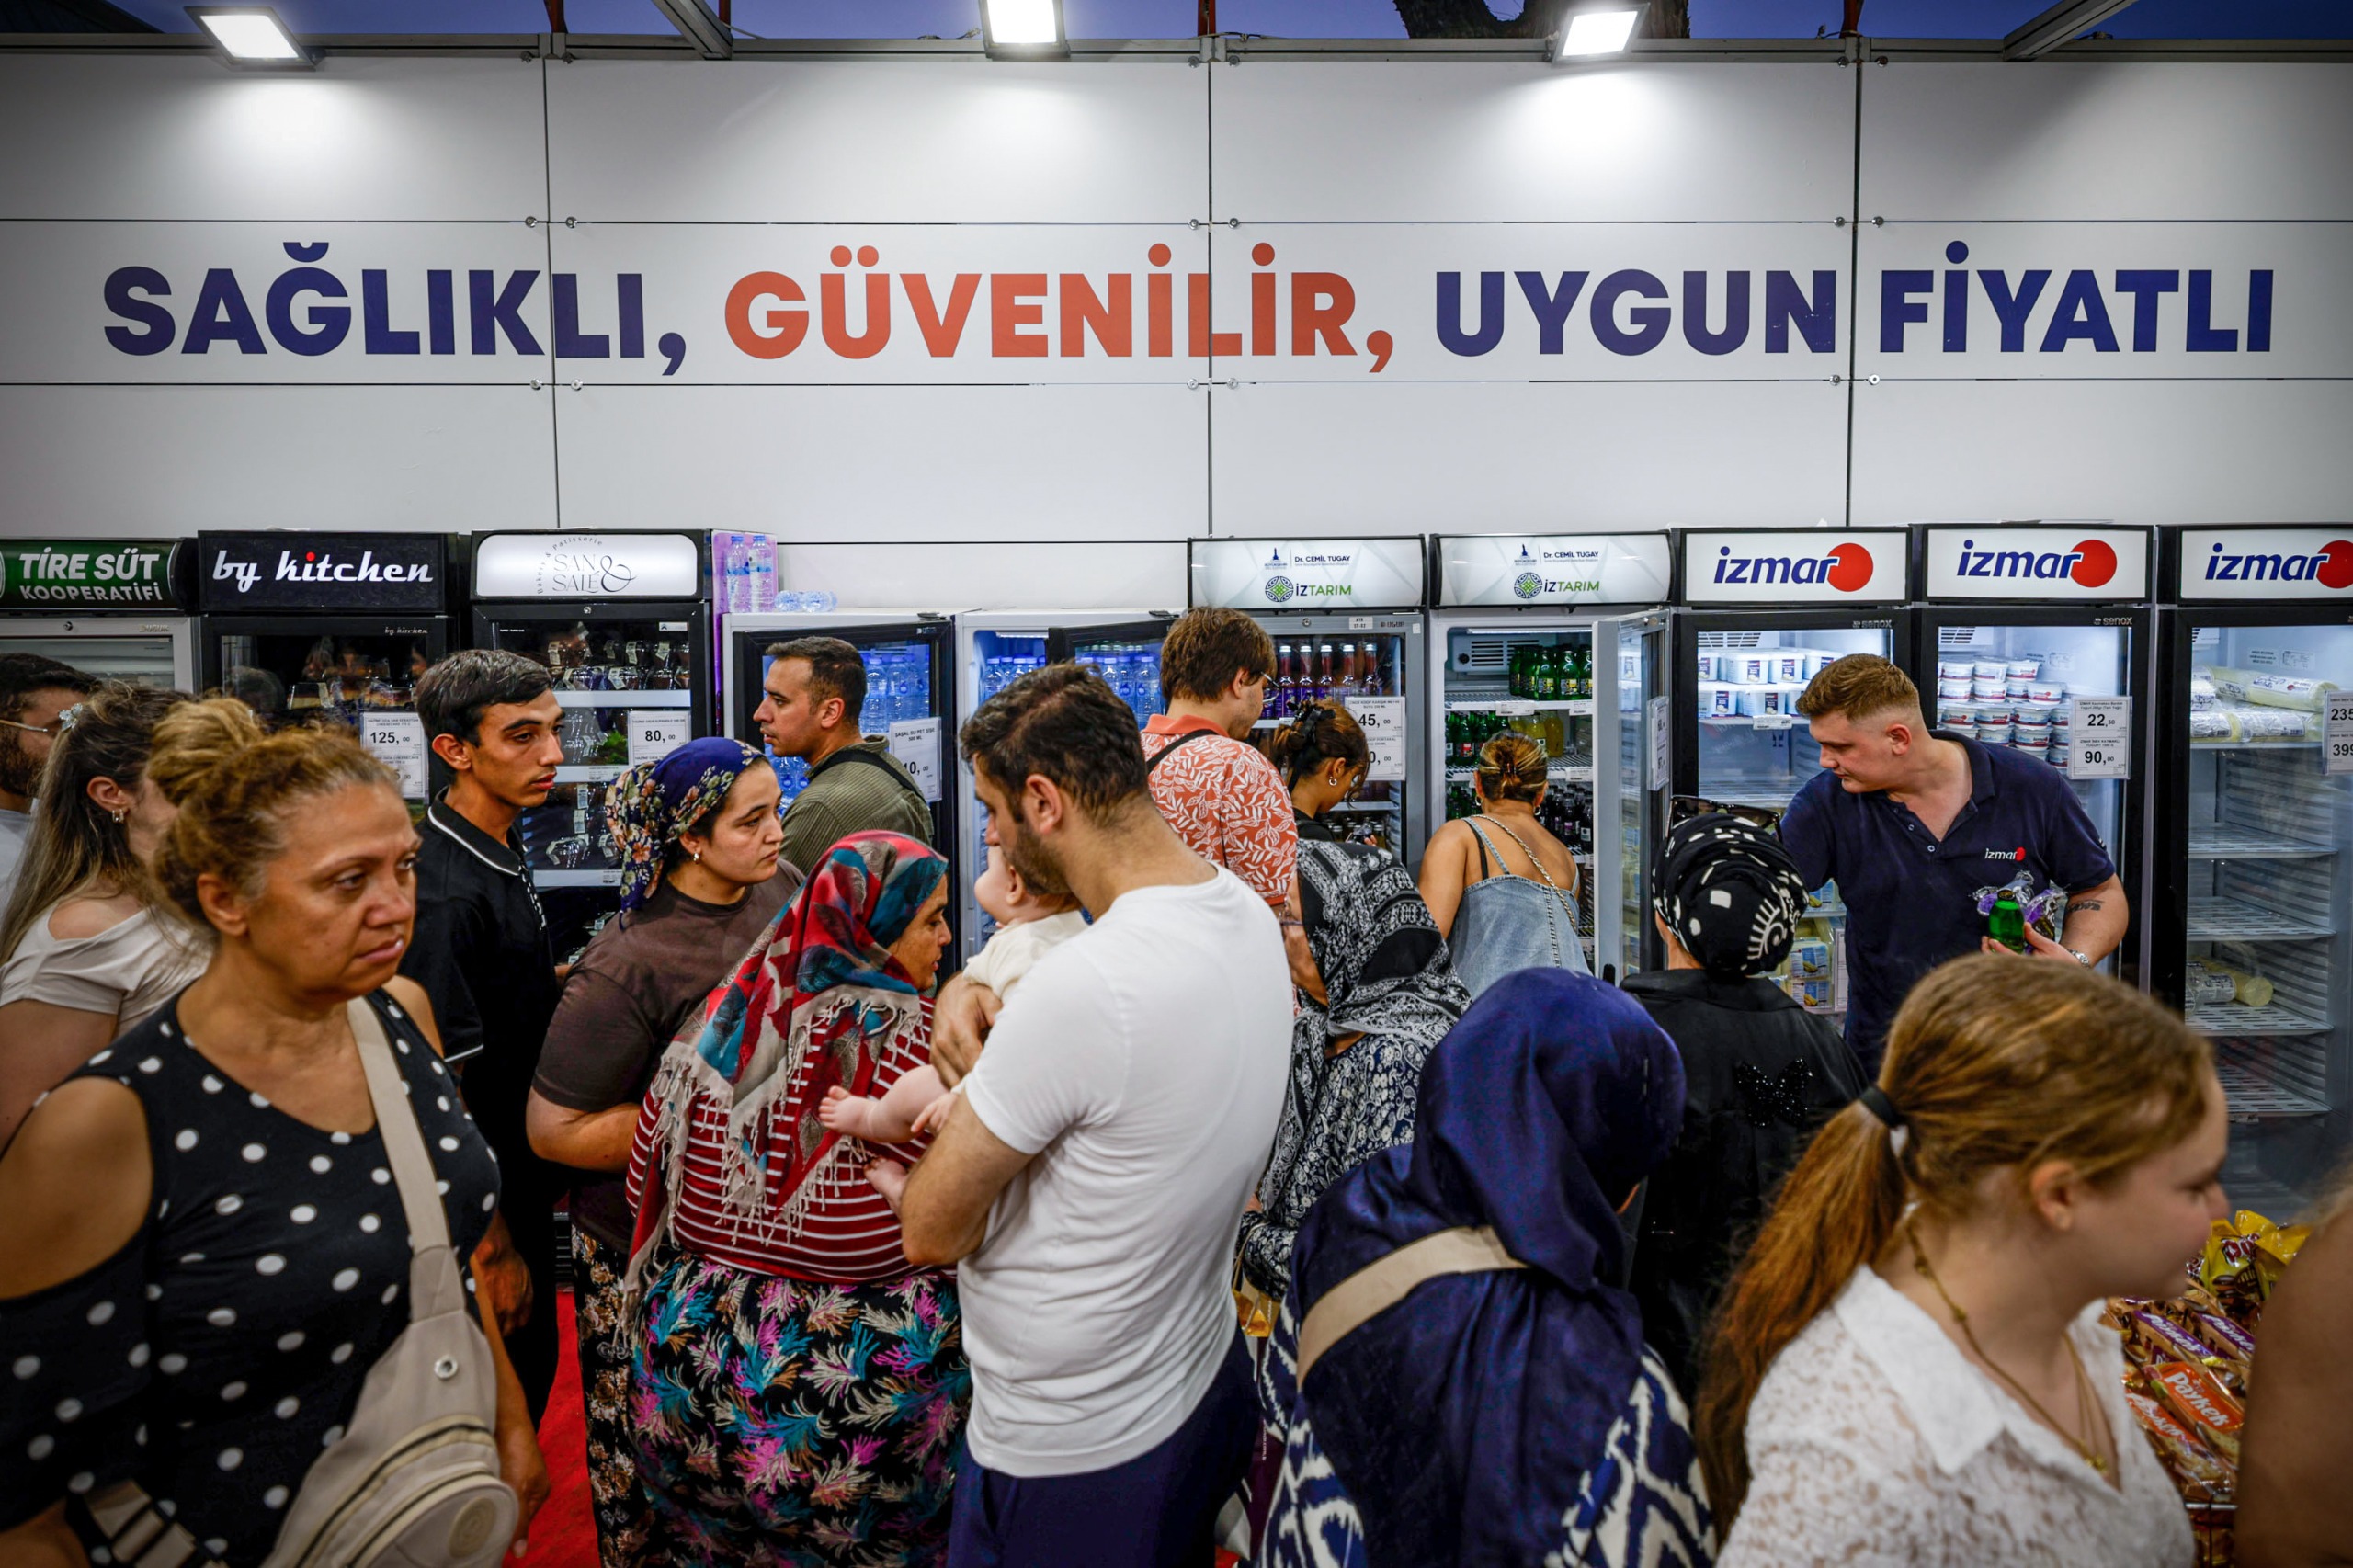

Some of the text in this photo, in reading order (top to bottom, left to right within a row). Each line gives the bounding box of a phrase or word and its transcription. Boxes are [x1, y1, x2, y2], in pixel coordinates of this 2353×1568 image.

[104, 240, 2274, 376] SAĞLIKLI, GÜVENİLİR, UYGUN FİYATLI
[19, 546, 160, 581] TİRE SÜT
[553, 553, 597, 572] SAN
[1713, 545, 1839, 585] izmar
[1957, 539, 2082, 579] izmar
[2204, 542, 2328, 582] izmar
[212, 550, 434, 593] by kitchen
[19, 581, 164, 601] KOOPERATİFİ
[2103, 616, 2133, 626] senox
[1358, 713, 1381, 728] 45,
[2087, 713, 2108, 728] 22,
[369, 732, 400, 745] 125,
[645, 730, 665, 744] 80,
[2084, 750, 2107, 766] 90,
[1984, 847, 2018, 860] izmar
